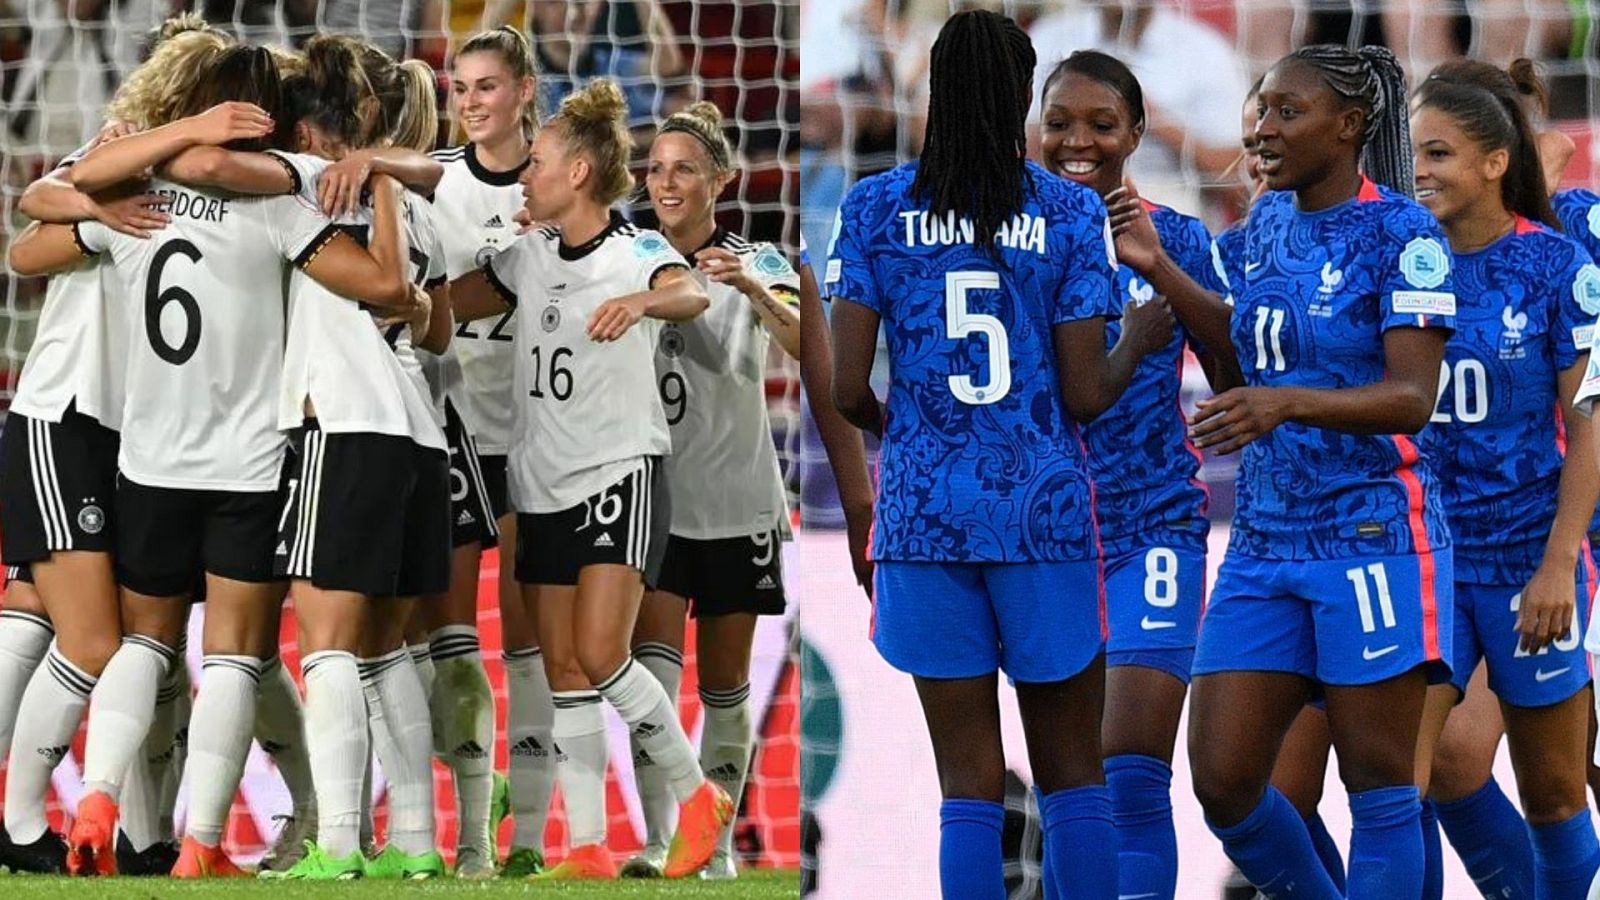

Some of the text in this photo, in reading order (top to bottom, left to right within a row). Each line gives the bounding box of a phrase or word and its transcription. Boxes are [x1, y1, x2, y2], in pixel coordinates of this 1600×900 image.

[141, 189, 230, 222] BERDORF
[899, 208, 1046, 254] TOUNARA
[144, 238, 205, 366] 6
[945, 270, 1012, 406] 5
[1254, 305, 1286, 372] 11
[529, 345, 574, 401] 16
[660, 371, 687, 426] 9
[1430, 358, 1488, 423] 20
[751, 529, 774, 567] 9
[1144, 547, 1179, 609] 8
[1346, 562, 1397, 633] 11
